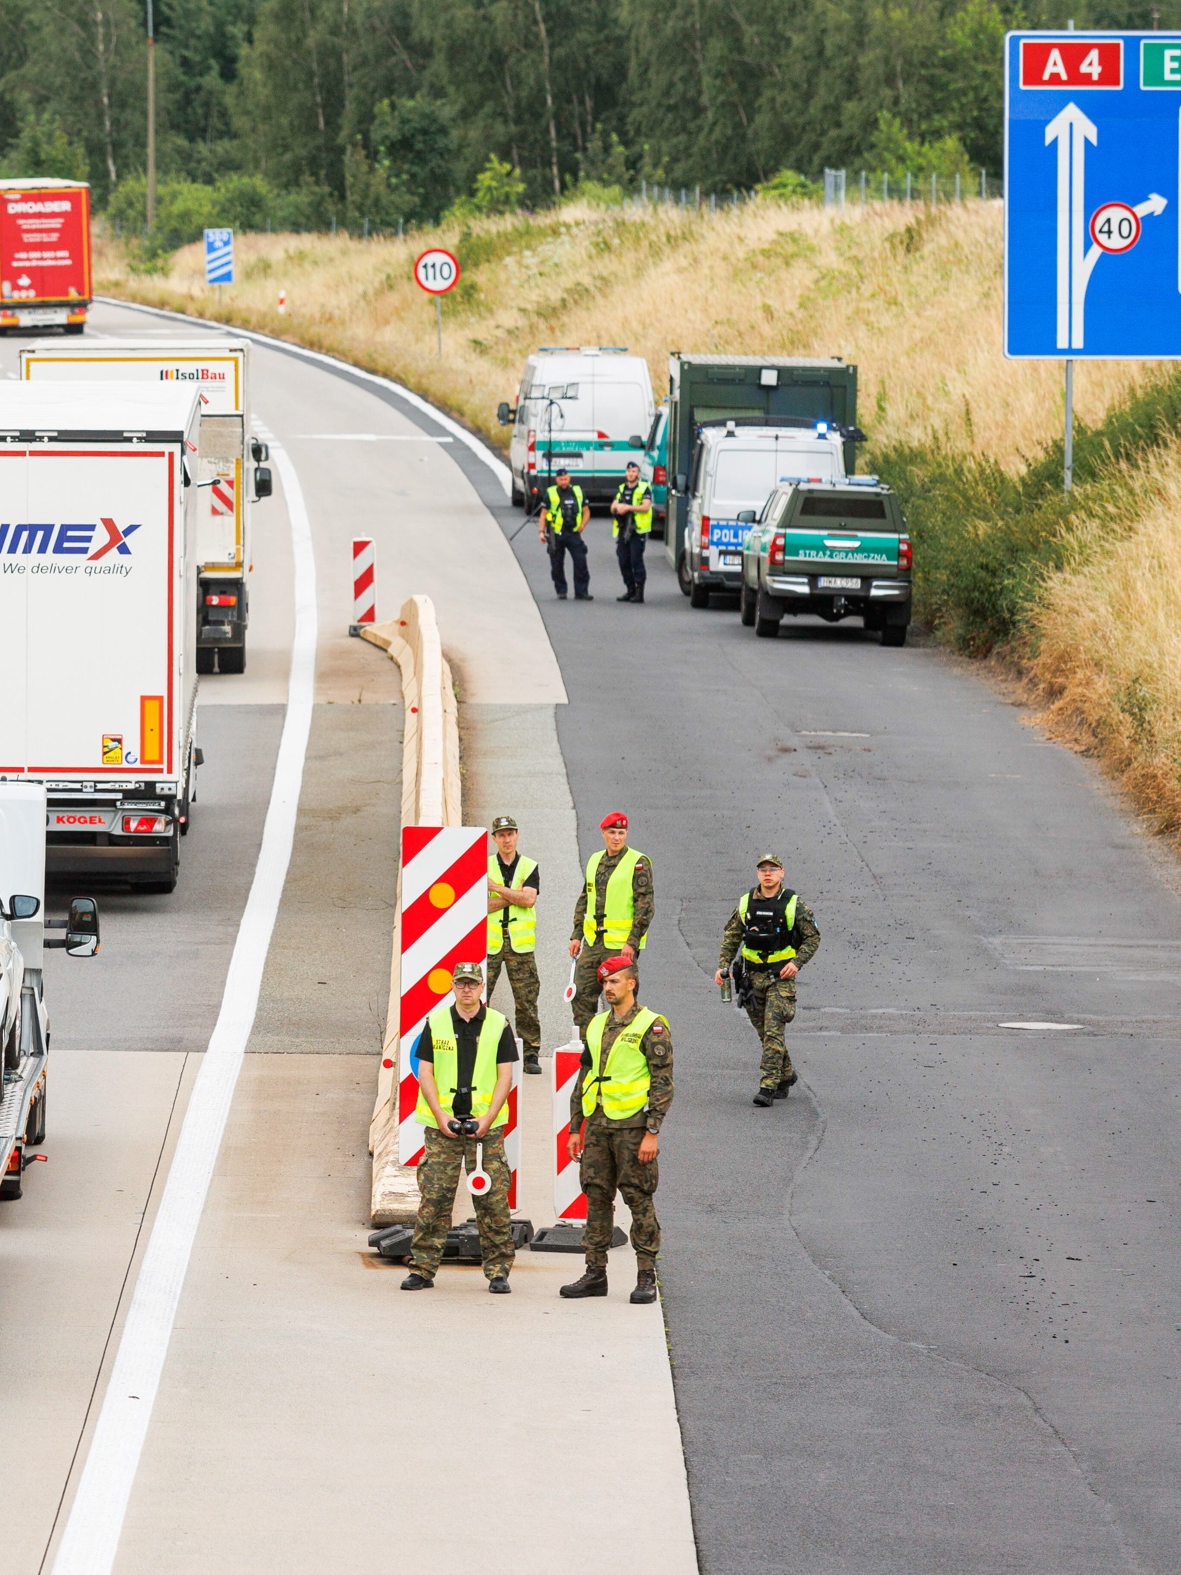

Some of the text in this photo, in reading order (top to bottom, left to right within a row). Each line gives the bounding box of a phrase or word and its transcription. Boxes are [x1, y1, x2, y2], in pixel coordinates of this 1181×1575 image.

[1042, 48, 1103, 81] A 4
[1164, 49, 1181, 81] E
[7, 200, 72, 214] DROADER
[1098, 217, 1133, 240] 40
[422, 262, 452, 281] 110
[175, 368, 226, 380] IsolBau
[799, 549, 888, 562] STRAŻ GRANICZNA
[2, 562, 133, 578] We deliver quality
[56, 814, 106, 825] KÖGEL
